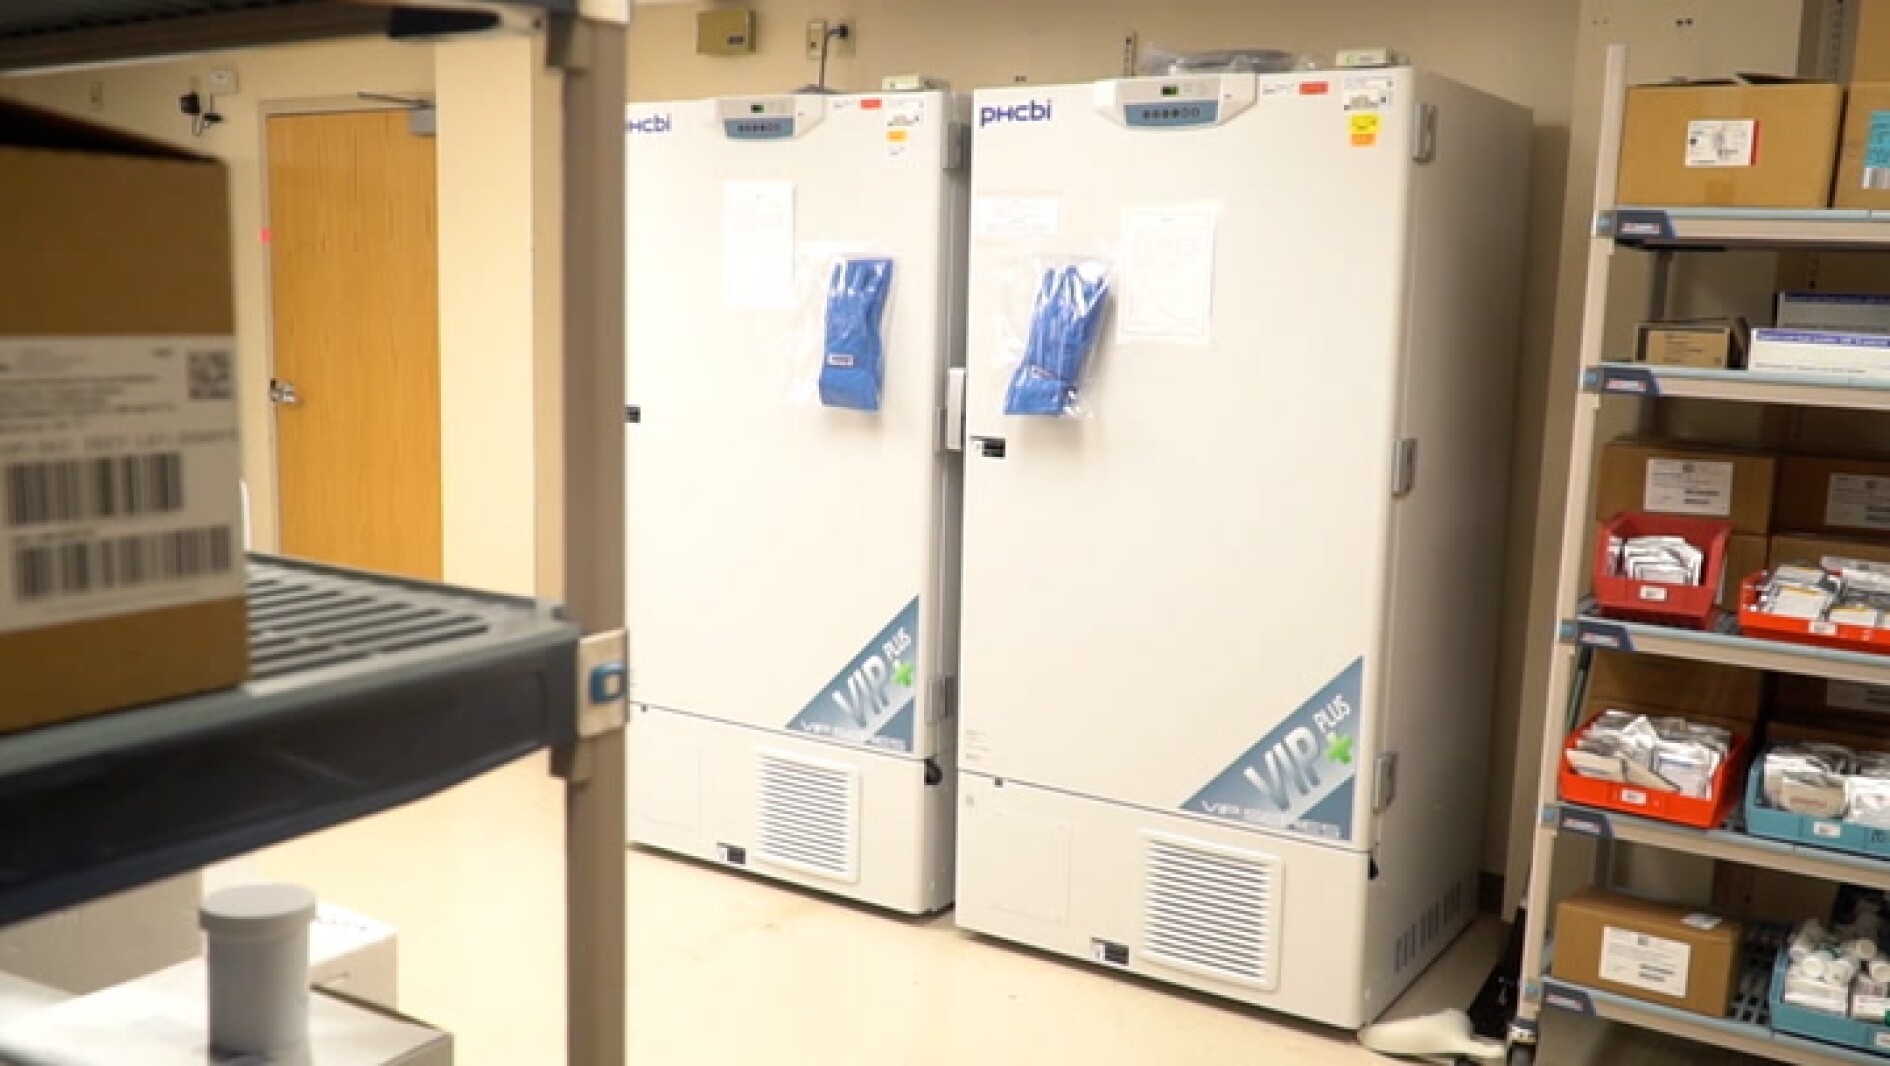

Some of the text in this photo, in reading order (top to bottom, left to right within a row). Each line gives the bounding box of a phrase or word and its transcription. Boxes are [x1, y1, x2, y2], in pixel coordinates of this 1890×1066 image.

[832, 655, 889, 729] VIP
[1243, 726, 1320, 812] VIP
[1313, 693, 1351, 733] PLUS
